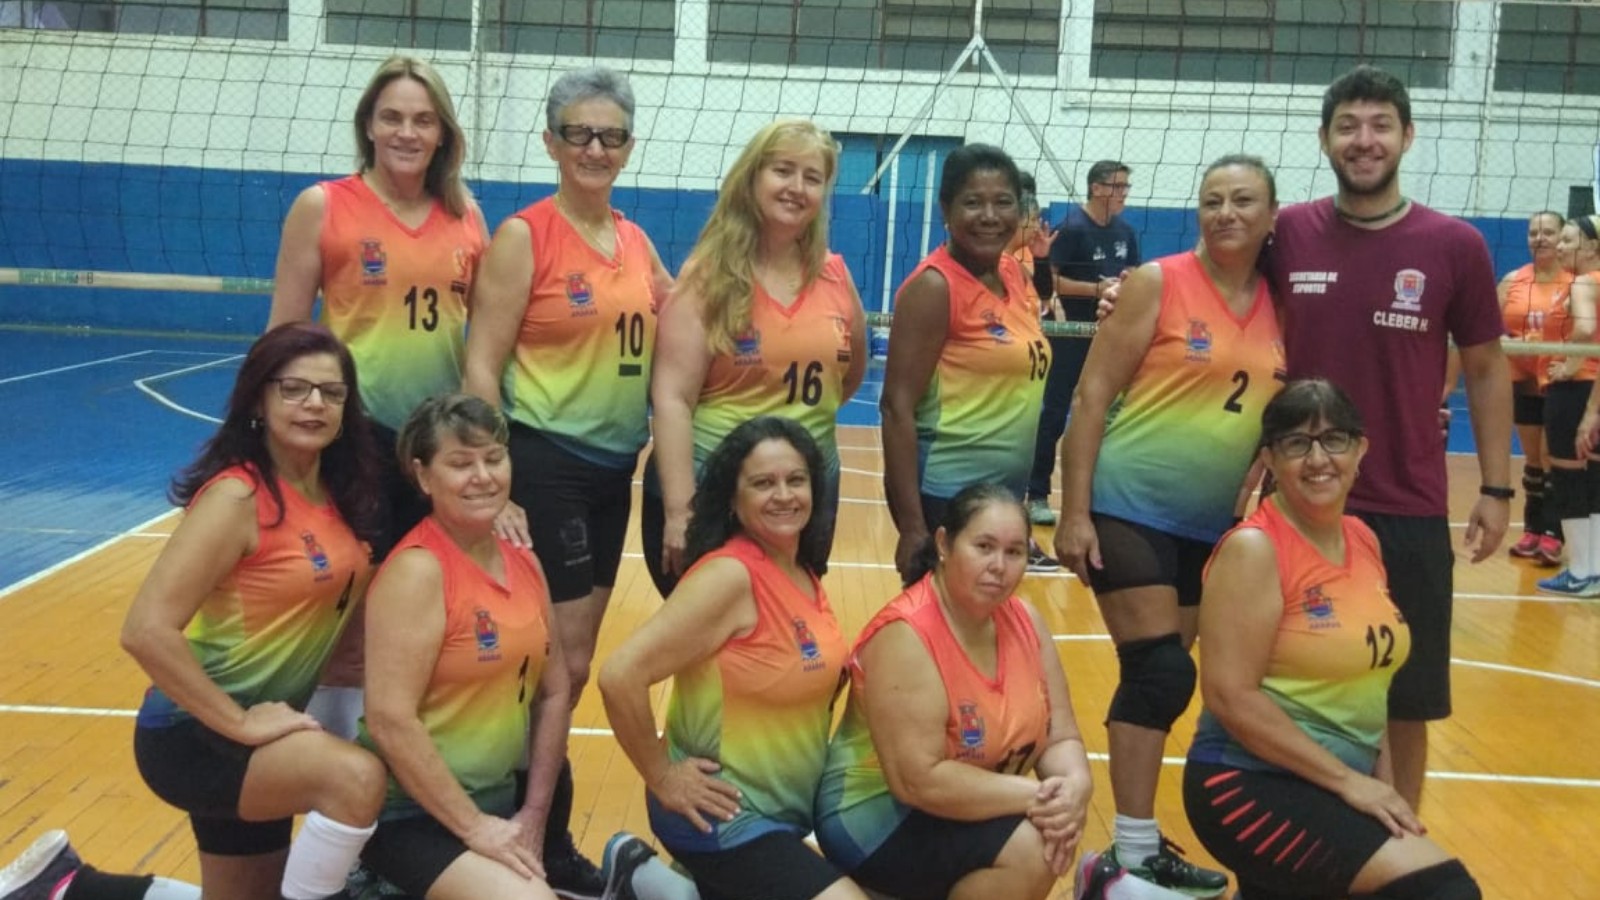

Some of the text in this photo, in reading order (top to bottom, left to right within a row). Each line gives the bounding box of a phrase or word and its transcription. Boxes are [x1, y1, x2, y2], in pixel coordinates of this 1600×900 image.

[404, 286, 439, 332] 13
[1373, 311, 1419, 330] CLEBER
[615, 311, 645, 358] 10
[783, 360, 824, 407] 16
[1027, 340, 1048, 381] 15
[1223, 370, 1250, 414] 2
[1366, 624, 1395, 671] 12
